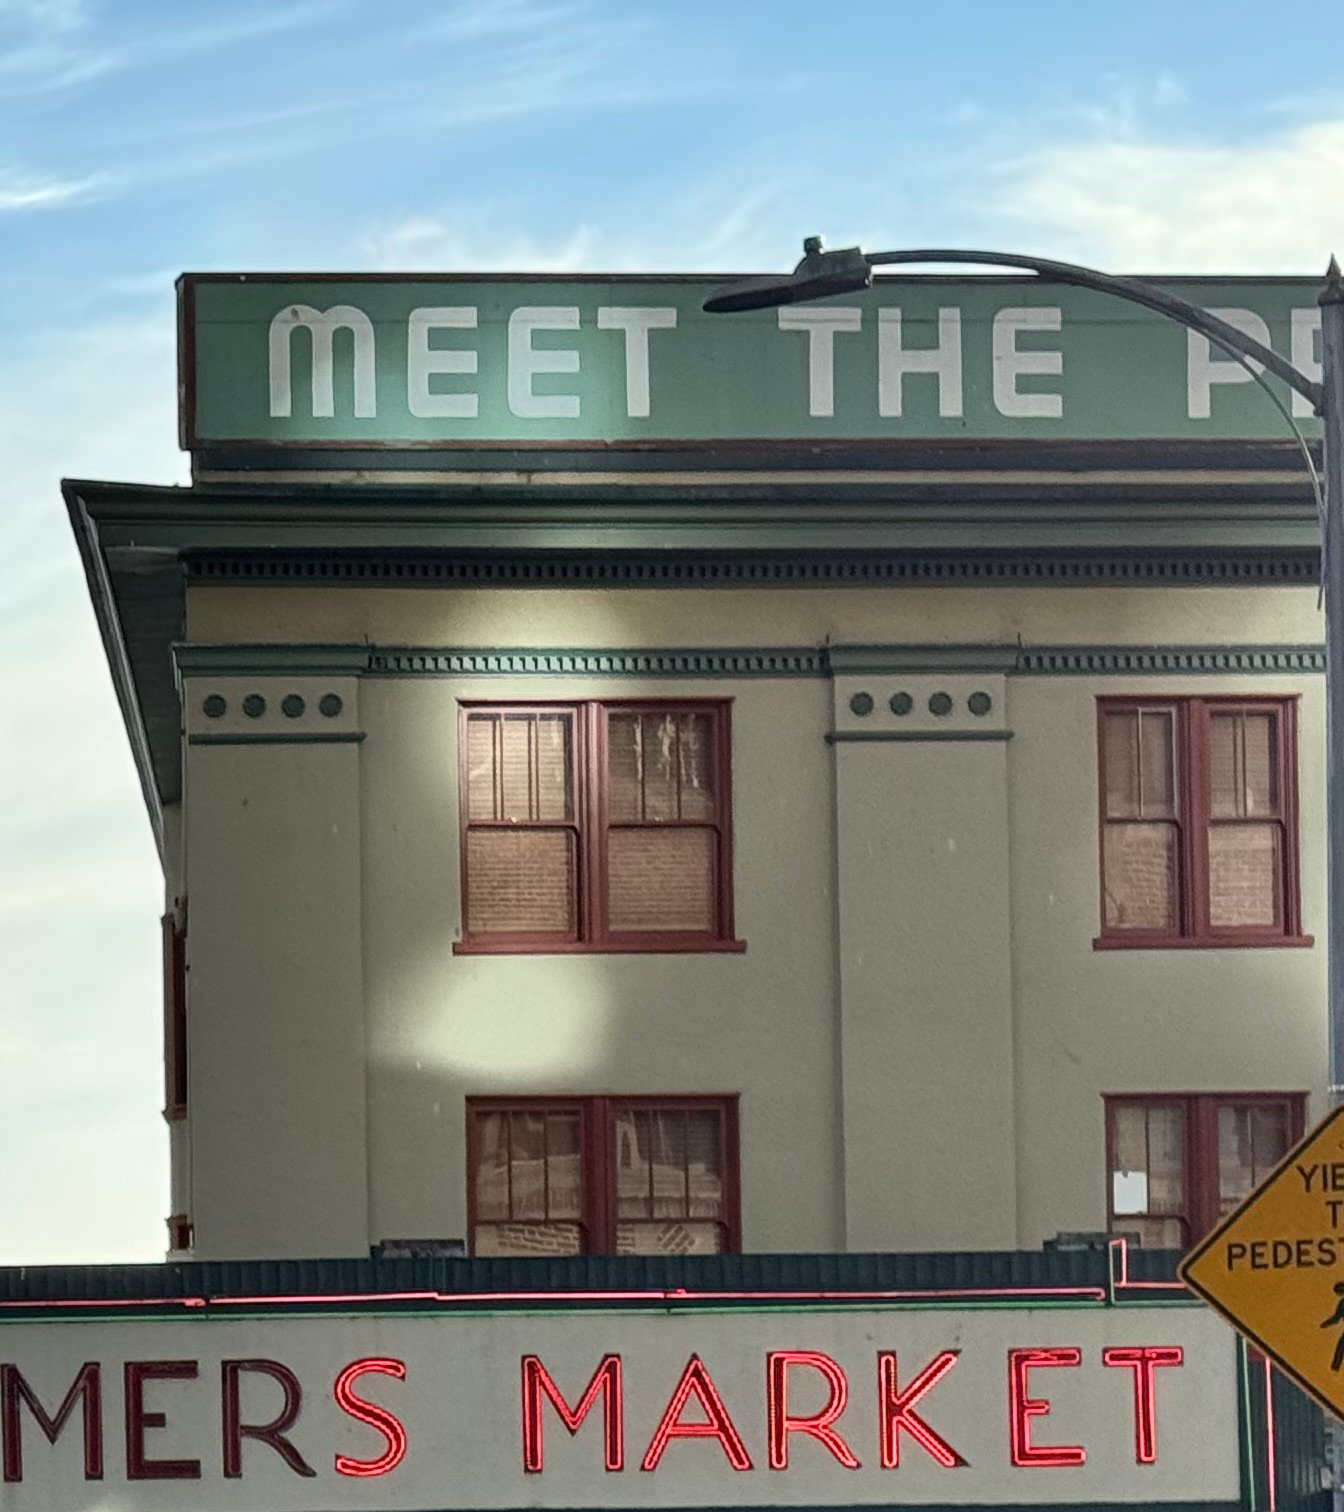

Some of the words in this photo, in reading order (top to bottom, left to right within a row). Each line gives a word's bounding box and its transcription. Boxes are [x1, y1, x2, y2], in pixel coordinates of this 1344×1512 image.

[268, 305, 677, 418] MEET
[778, 306, 1065, 418] THE
[521, 1346, 1184, 1474] MARKET
